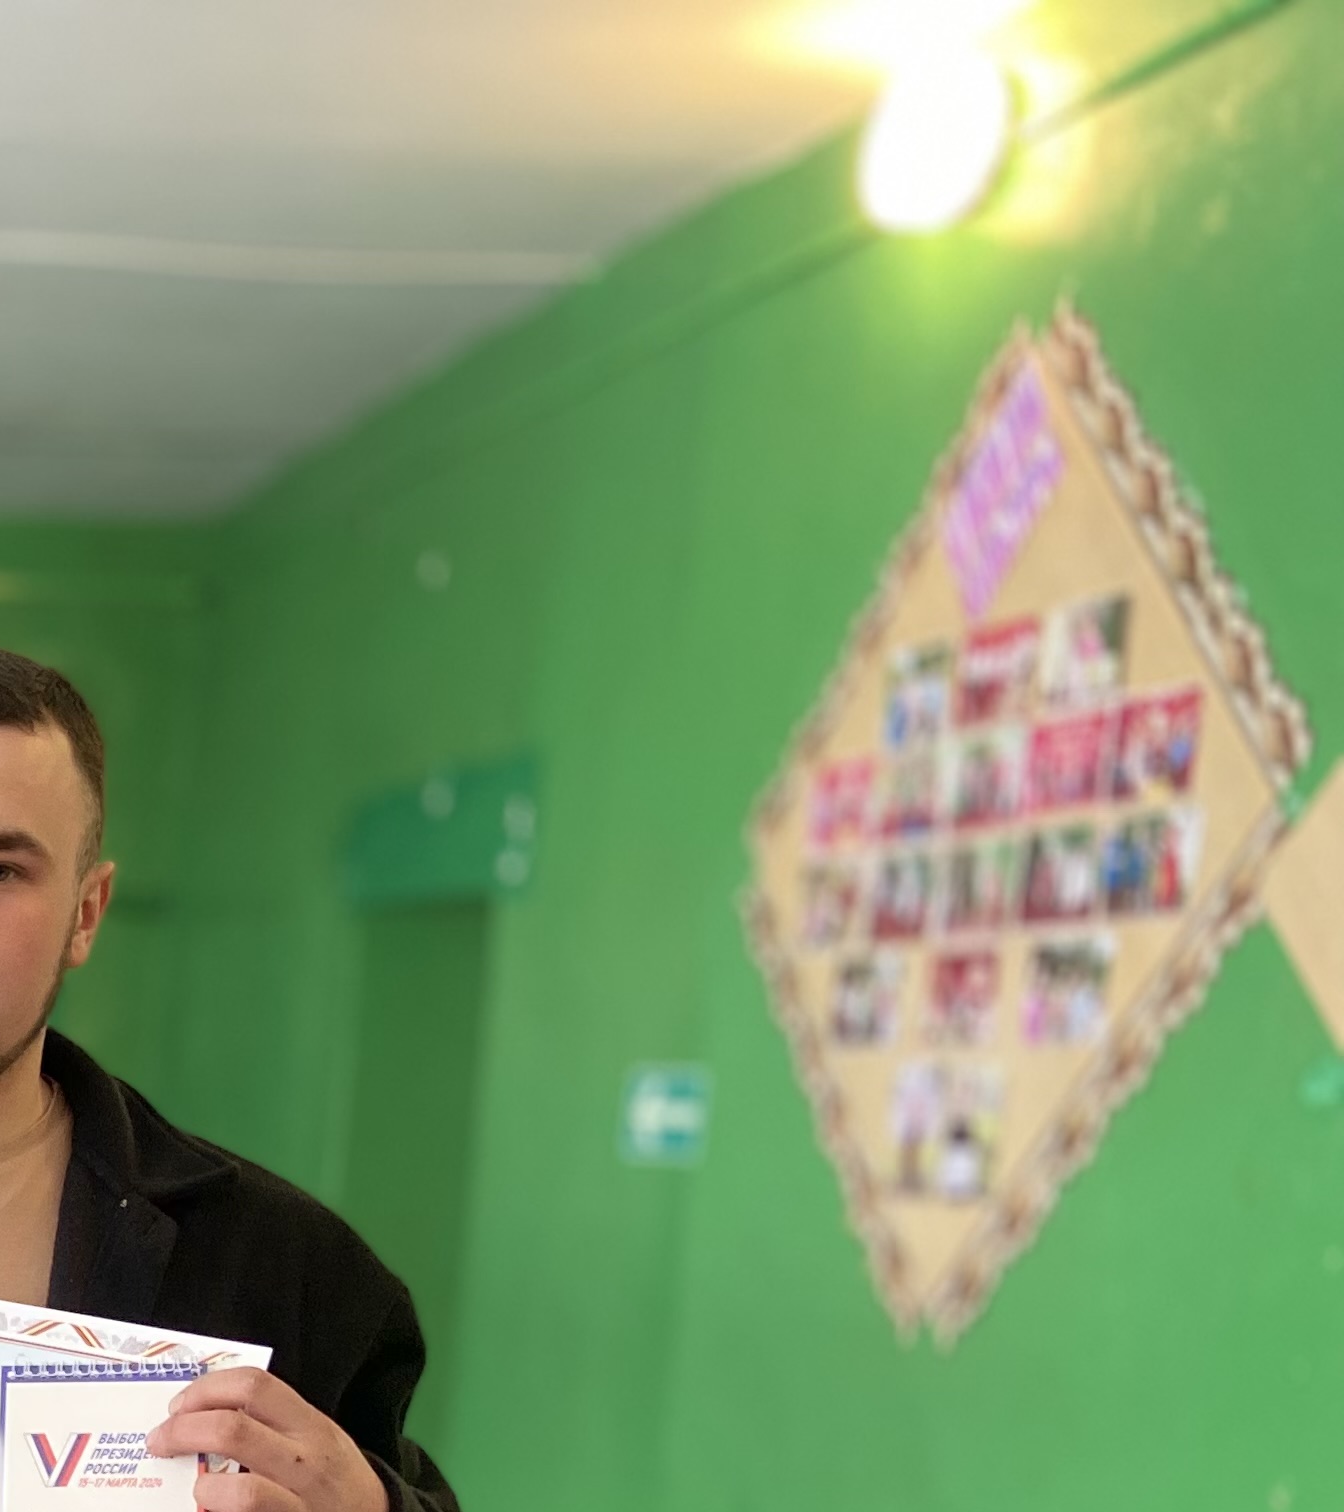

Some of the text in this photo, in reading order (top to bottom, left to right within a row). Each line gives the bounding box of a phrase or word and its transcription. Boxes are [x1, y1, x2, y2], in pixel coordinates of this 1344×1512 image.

[97, 1432, 146, 1445] ВЫБОР
[90, 1448, 174, 1462] ПРЕЗИДЕ
[83, 1463, 138, 1475] РОССИИ
[105, 1478, 138, 1488] МАРТА
[139, 1478, 163, 1489] 2024
